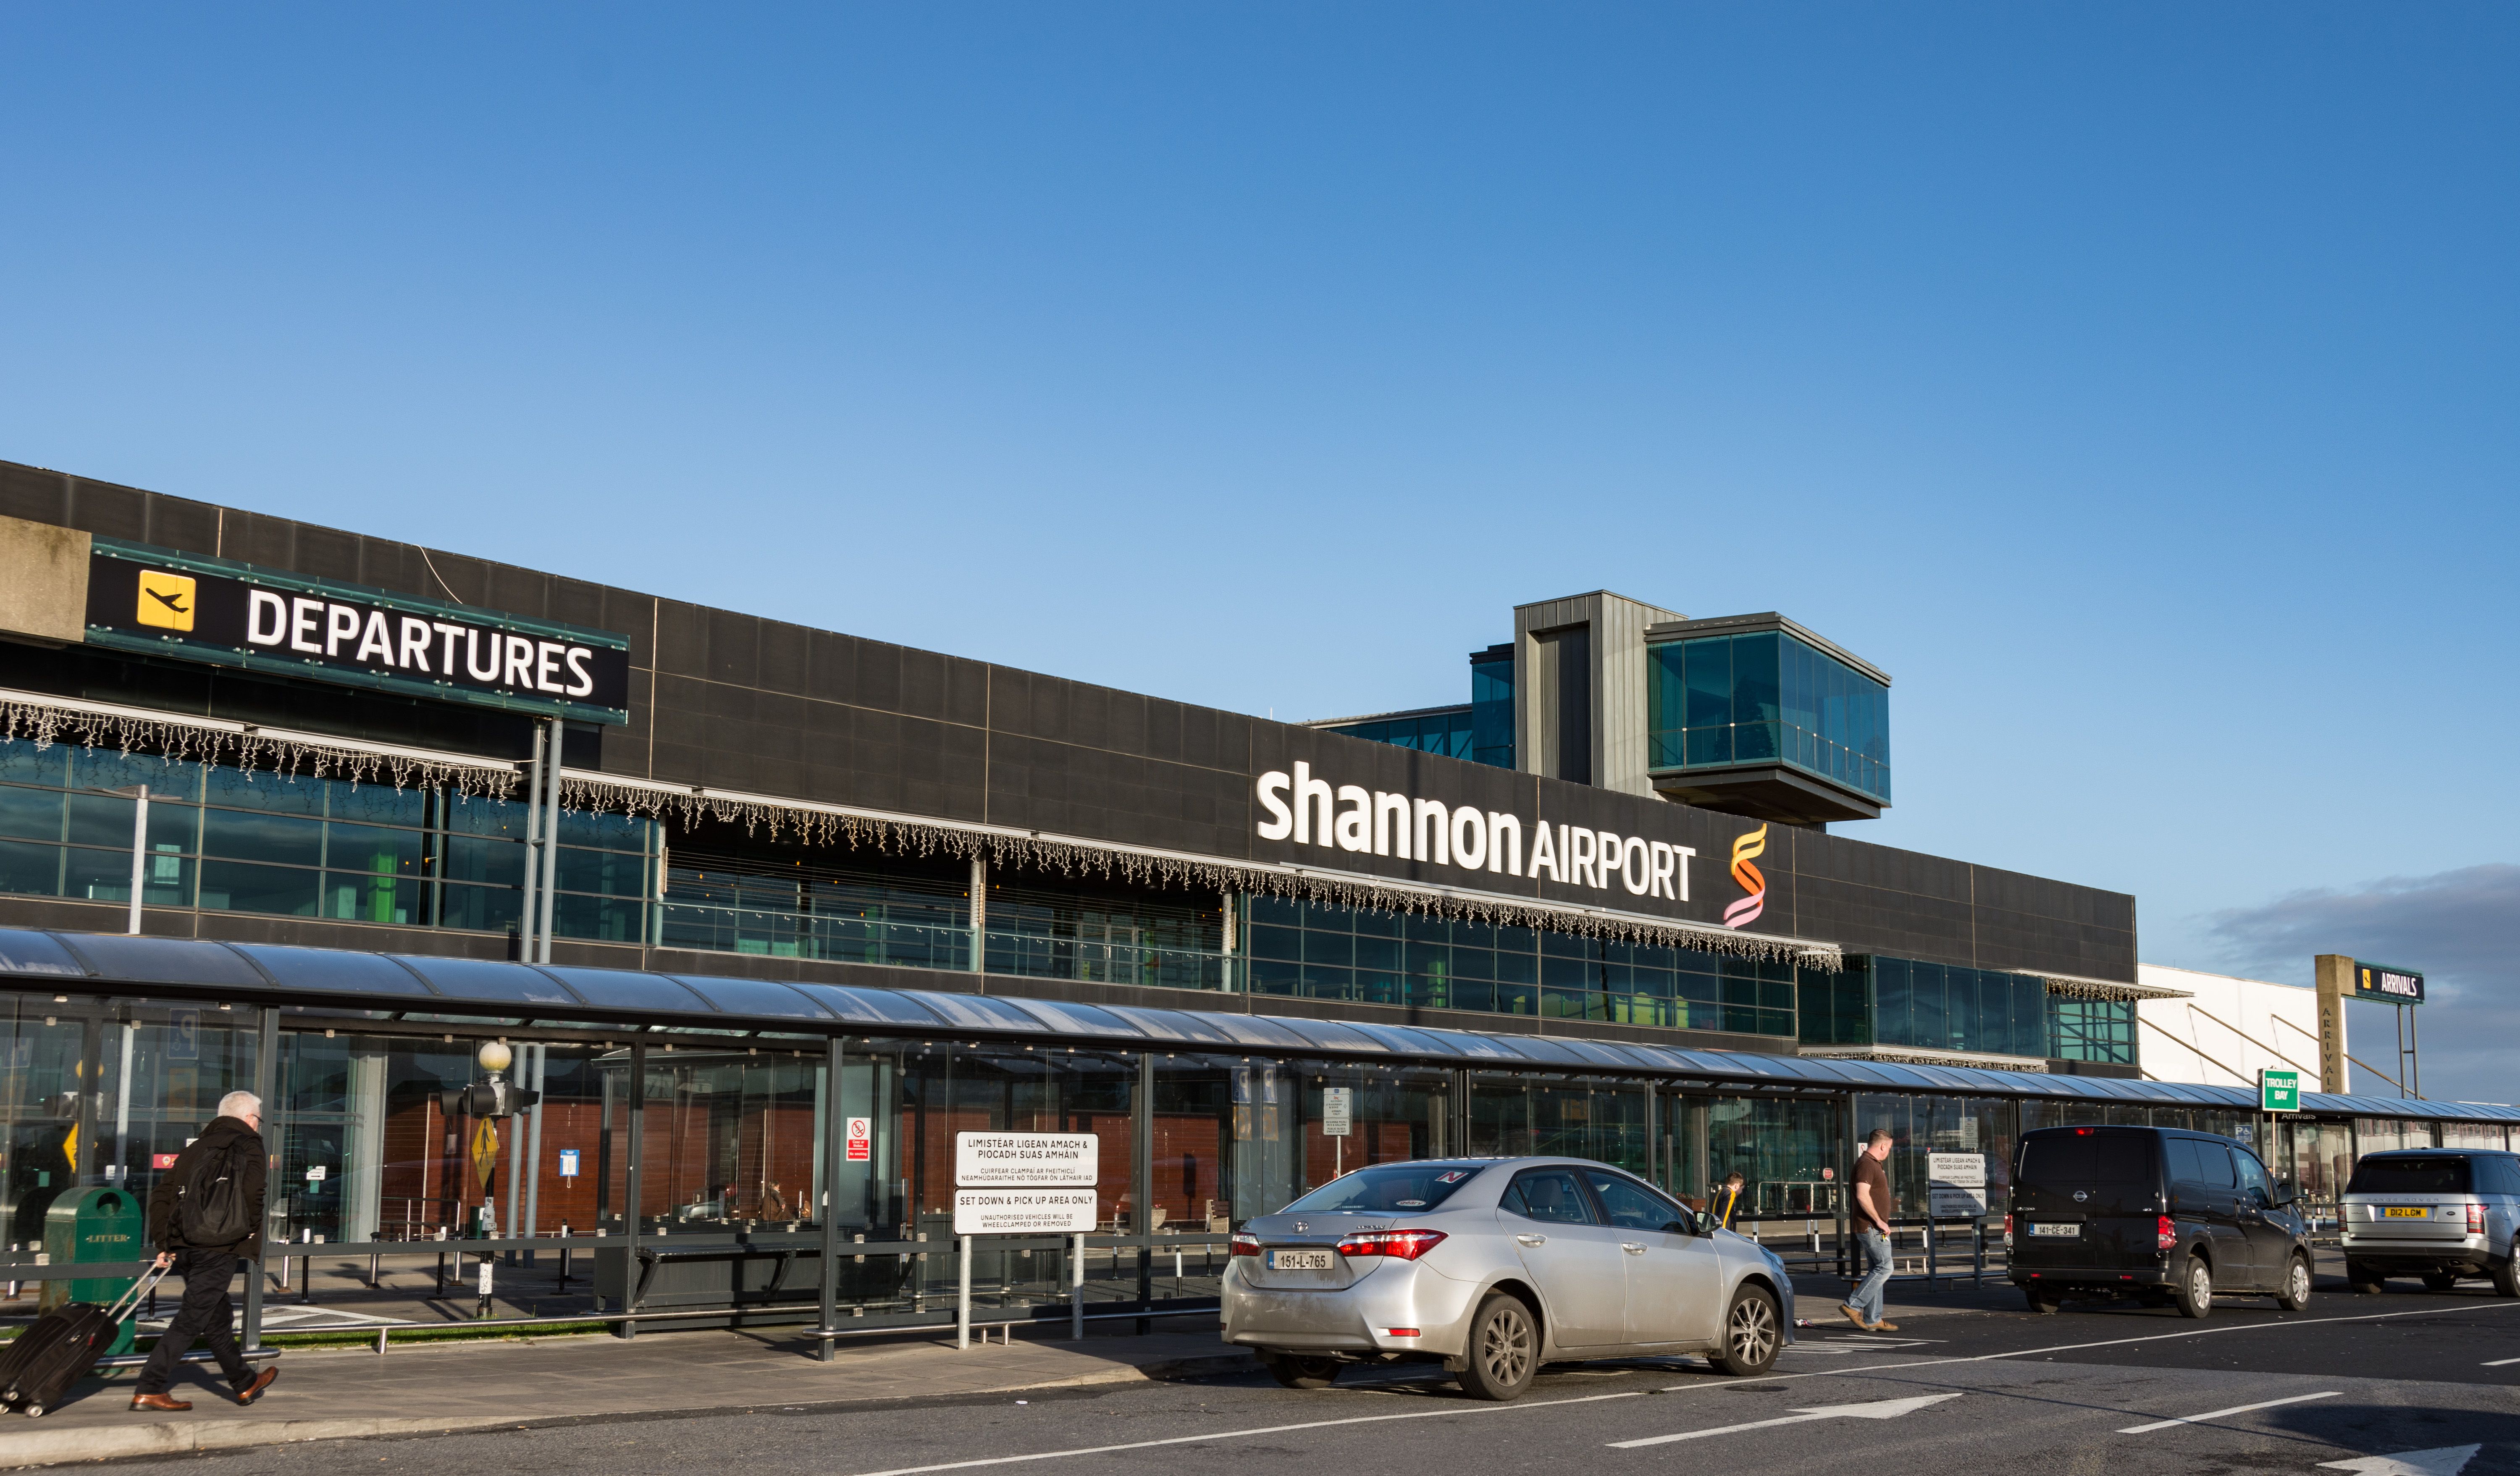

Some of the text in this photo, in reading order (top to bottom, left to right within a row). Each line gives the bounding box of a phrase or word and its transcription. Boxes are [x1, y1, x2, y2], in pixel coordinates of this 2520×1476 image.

[247, 589, 593, 697] DEPARTURES
[1257, 761, 1697, 902] shannon AIRPORT
[2381, 972, 2417, 996] ARRIVALS
[2265, 1078, 2297, 1088] TROLLEY
[2274, 1090, 2288, 1100] BAY
[2236, 1127, 2243, 1135] P
[968, 1137, 1013, 1148] LIMISTÉAR
[1017, 1140, 1047, 1148] LIGEAN
[1045, 1149, 1078, 1158] AMHÁIN
[1436, 1171, 1466, 1182] N
[960, 1197, 976, 1205] SET
[88, 1234, 128, 1243] LITTER
[1281, 1255, 1326, 1268] 151-L-765
